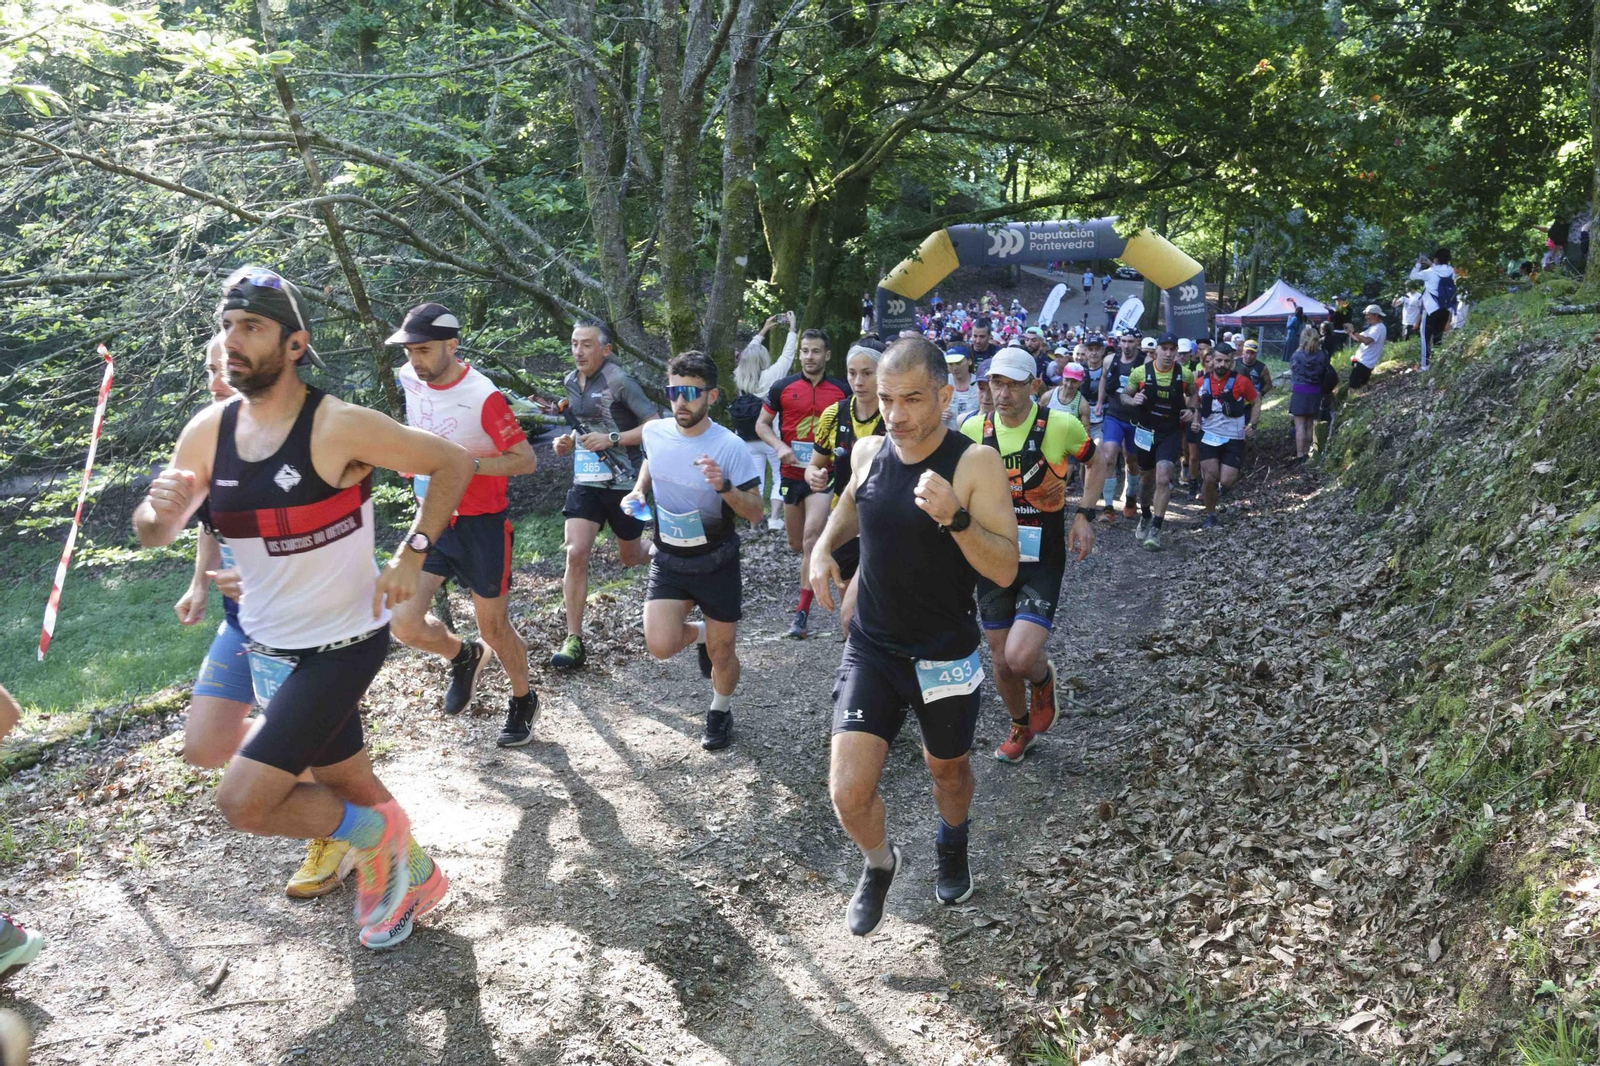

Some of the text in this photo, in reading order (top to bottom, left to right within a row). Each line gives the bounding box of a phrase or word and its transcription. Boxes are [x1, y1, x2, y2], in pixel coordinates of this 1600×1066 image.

[1029, 228, 1095, 242] Deputación
[1029, 240, 1095, 251] Pontevedra
[582, 462, 600, 472] 365
[670, 526, 684, 537] 71
[939, 660, 972, 682] 493
